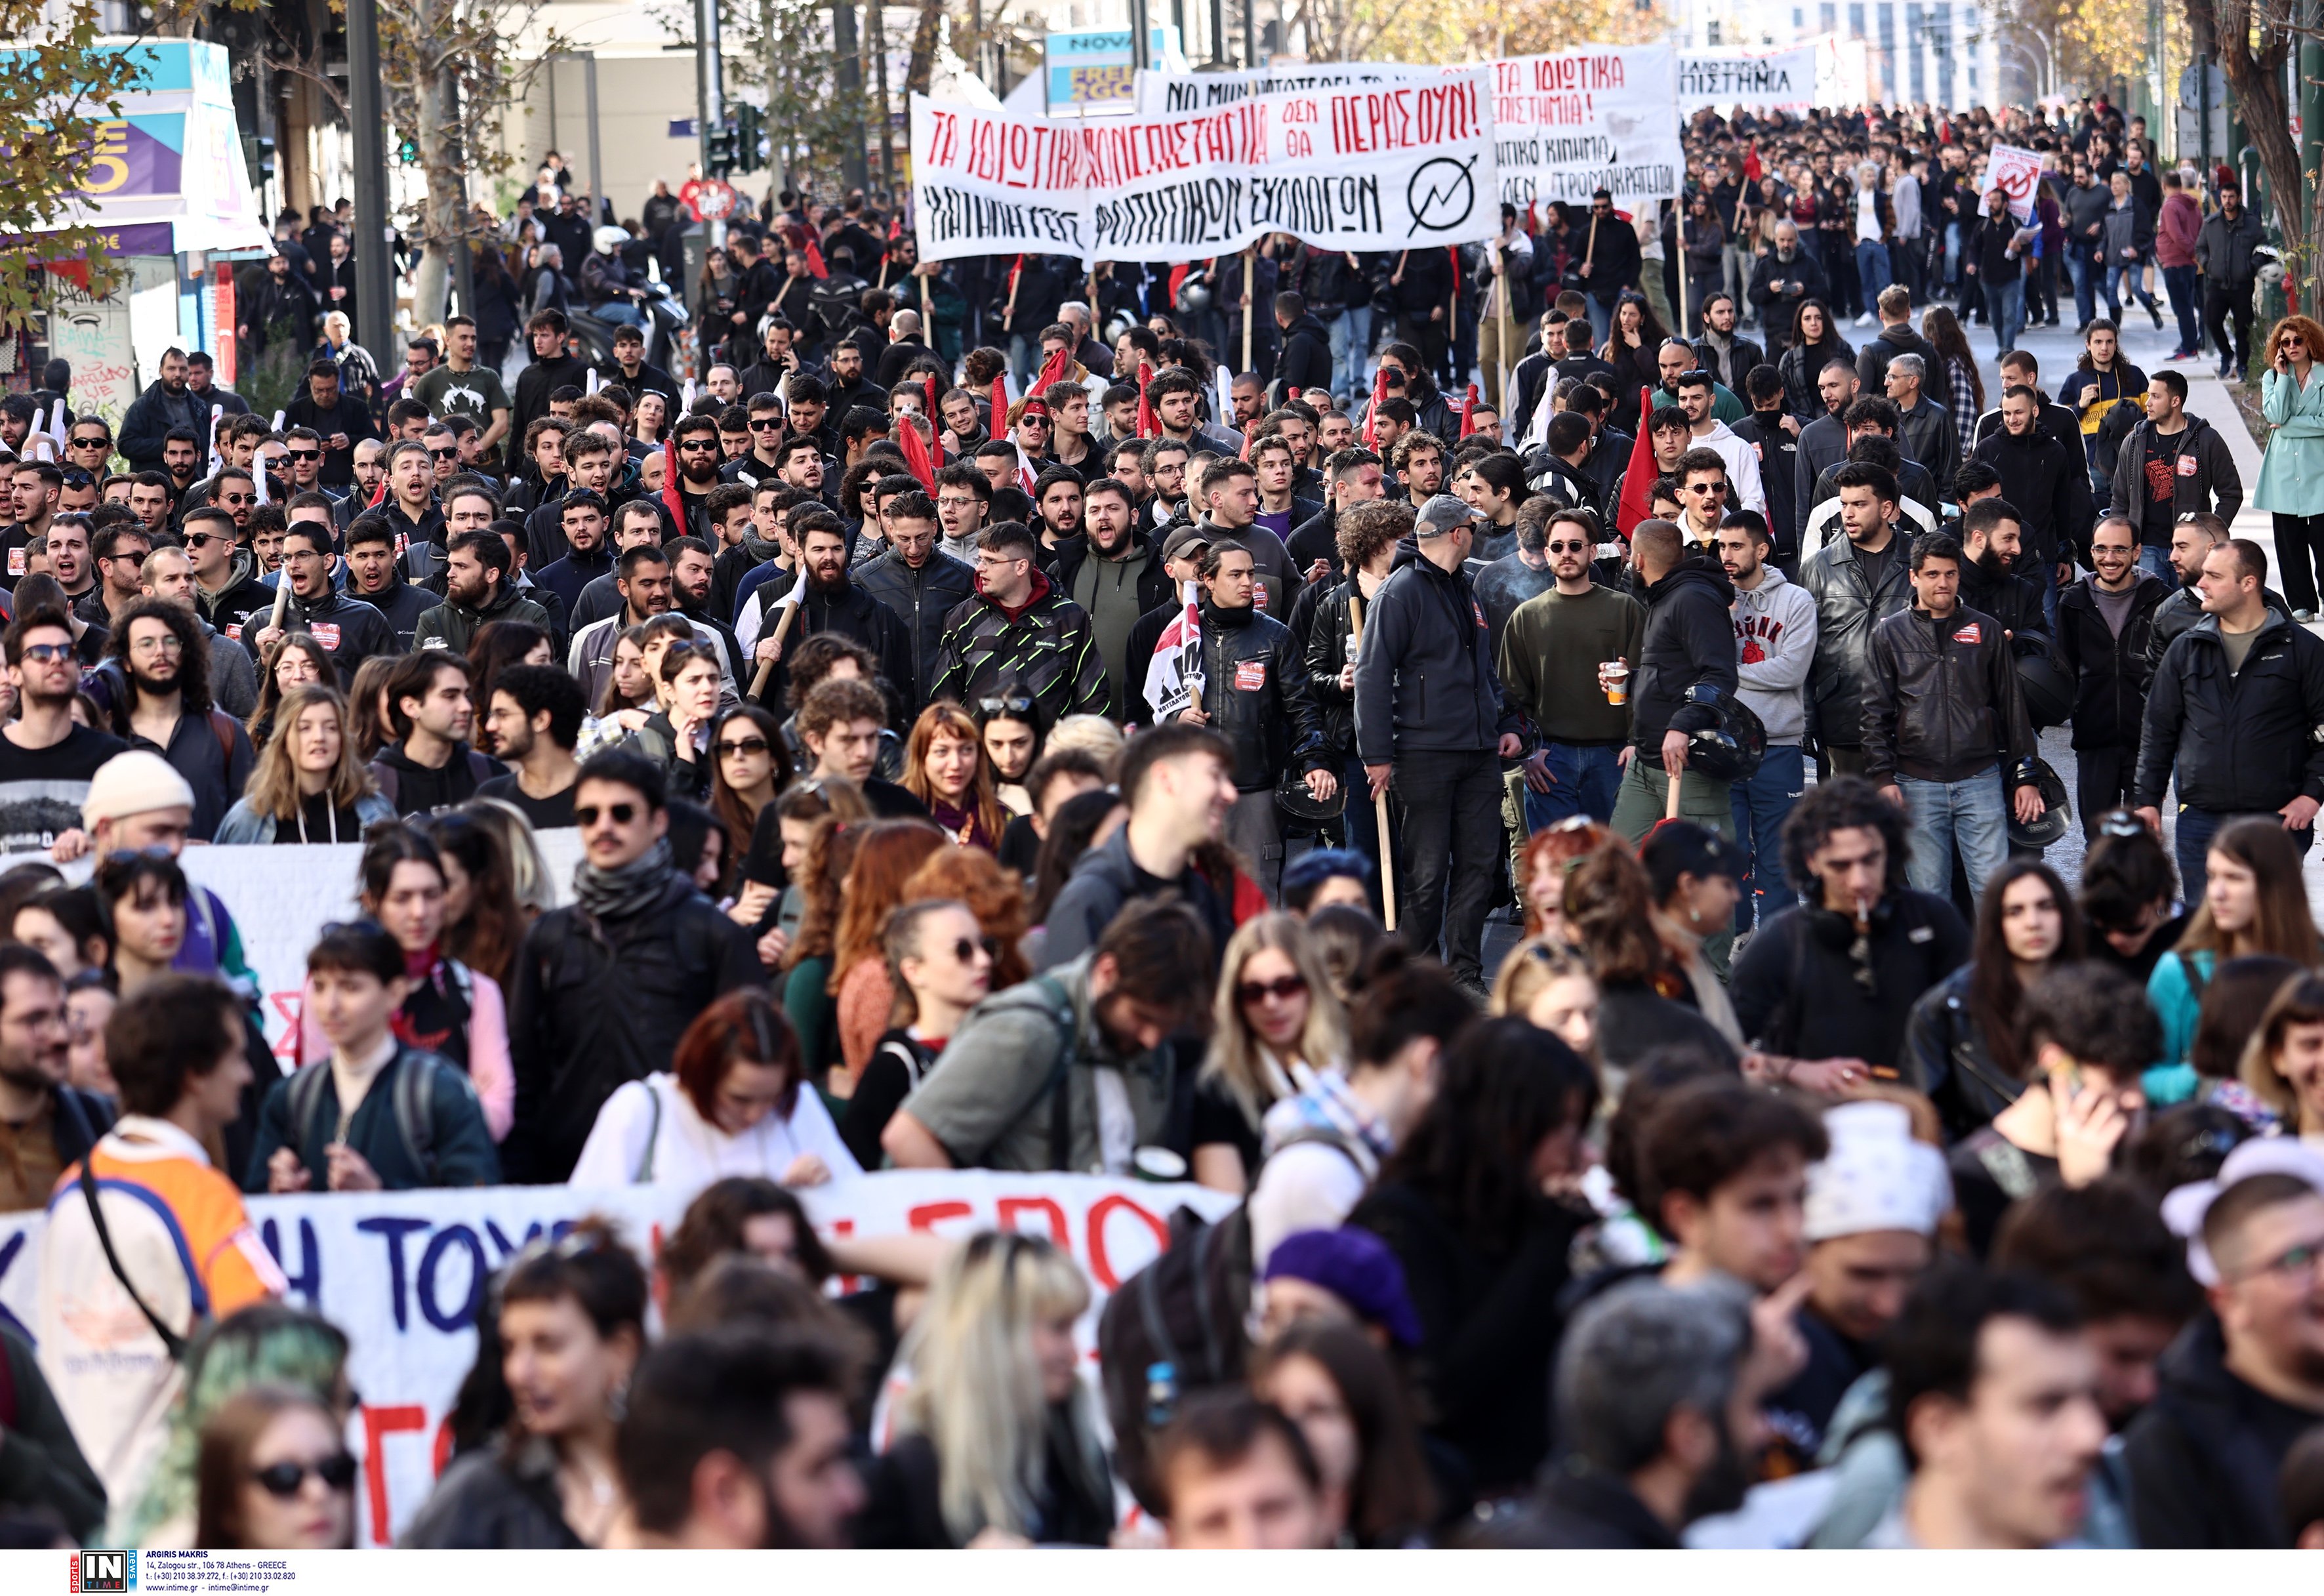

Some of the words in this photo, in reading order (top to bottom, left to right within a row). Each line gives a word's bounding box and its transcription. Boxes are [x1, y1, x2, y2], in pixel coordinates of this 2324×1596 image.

[1069, 35, 1133, 51] NOV
[1488, 63, 1521, 94] ΤΑ
[1534, 55, 1625, 92] ΙΔΙΩΤΙΚΑ
[1282, 98, 1318, 123] ΔΕΝ
[1331, 79, 1482, 155] ΠΕΡΑΣΟΥΝ!
[928, 111, 958, 168] ΤΑ
[1286, 128, 1313, 157] ΘΑ
